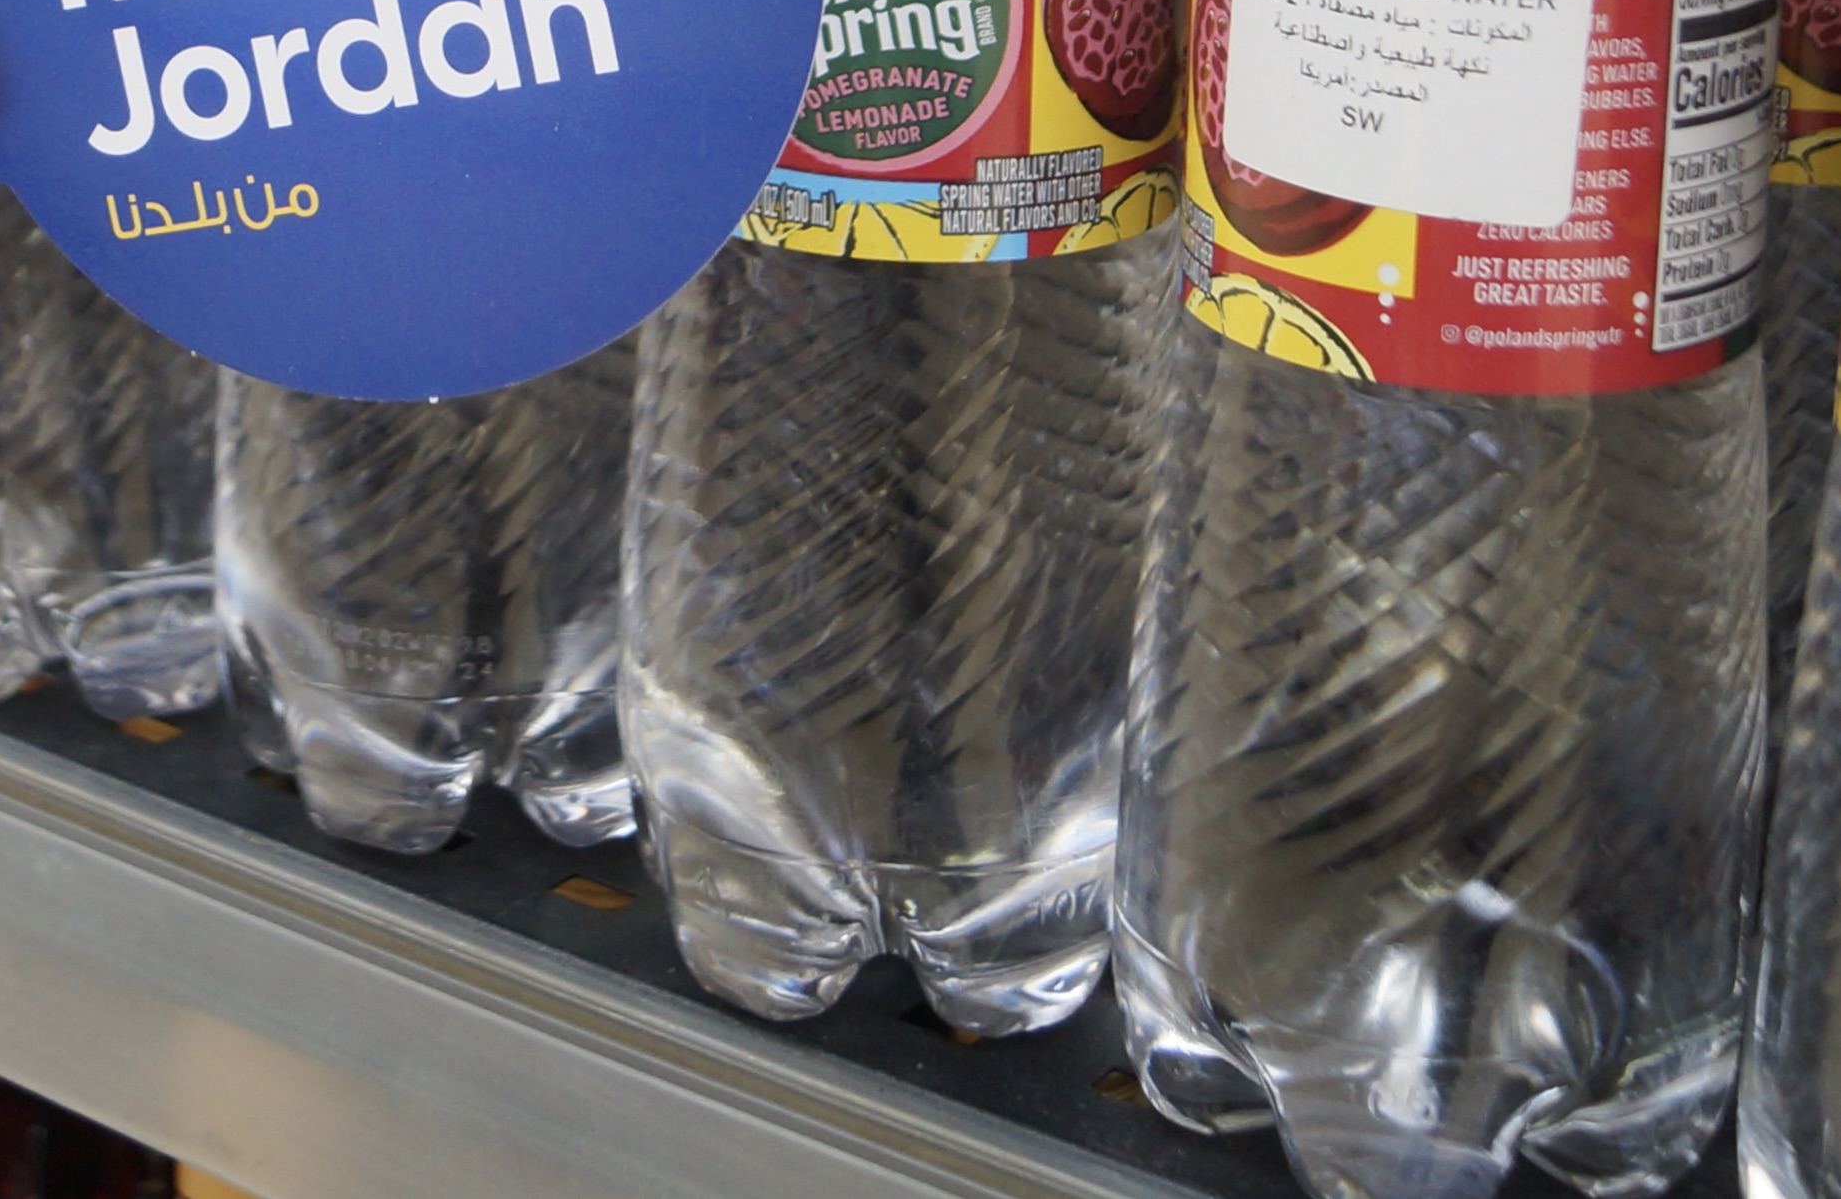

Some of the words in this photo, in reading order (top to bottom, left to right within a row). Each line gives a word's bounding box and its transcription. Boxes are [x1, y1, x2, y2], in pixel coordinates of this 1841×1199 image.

[974, 5, 998, 47] BRAND
[1601, 61, 1659, 83] WATER
[1674, 54, 1765, 112] Calories
[815, 96, 950, 134] LEMONADE
[1340, 105, 1385, 133] SW
[854, 125, 922, 150] FLAVOR
[1611, 126, 1656, 150] ELSE.
[976, 155, 1047, 182] NATURALLY
[1048, 146, 1102, 177] FLAVORED
[1575, 168, 1632, 191] ENERS
[1669, 153, 1707, 183] Total
[1708, 148, 1728, 176] Fat
[233, 174, 319, 230] من
[940, 184, 990, 209] SPRING
[992, 181, 1034, 207] WATER
[1036, 178, 1066, 204] WITH
[1068, 172, 1102, 200] OTHER
[1666, 188, 1717, 217] Sodium
[105, 180, 227, 240] بلدنا
[942, 208, 1000, 234] NATURAL
[1002, 204, 1056, 231] FLAVORS
[1057, 200, 1080, 226] AND
[1527, 218, 1614, 242] CALORIES
[1665, 220, 1702, 251] Total
[1451, 255, 1506, 278] JUST
[1507, 254, 1631, 282] REFRESHING
[1662, 253, 1714, 286] Protein
[1473, 282, 1543, 306] GREAT
[1543, 282, 1610, 306] TASTE.
